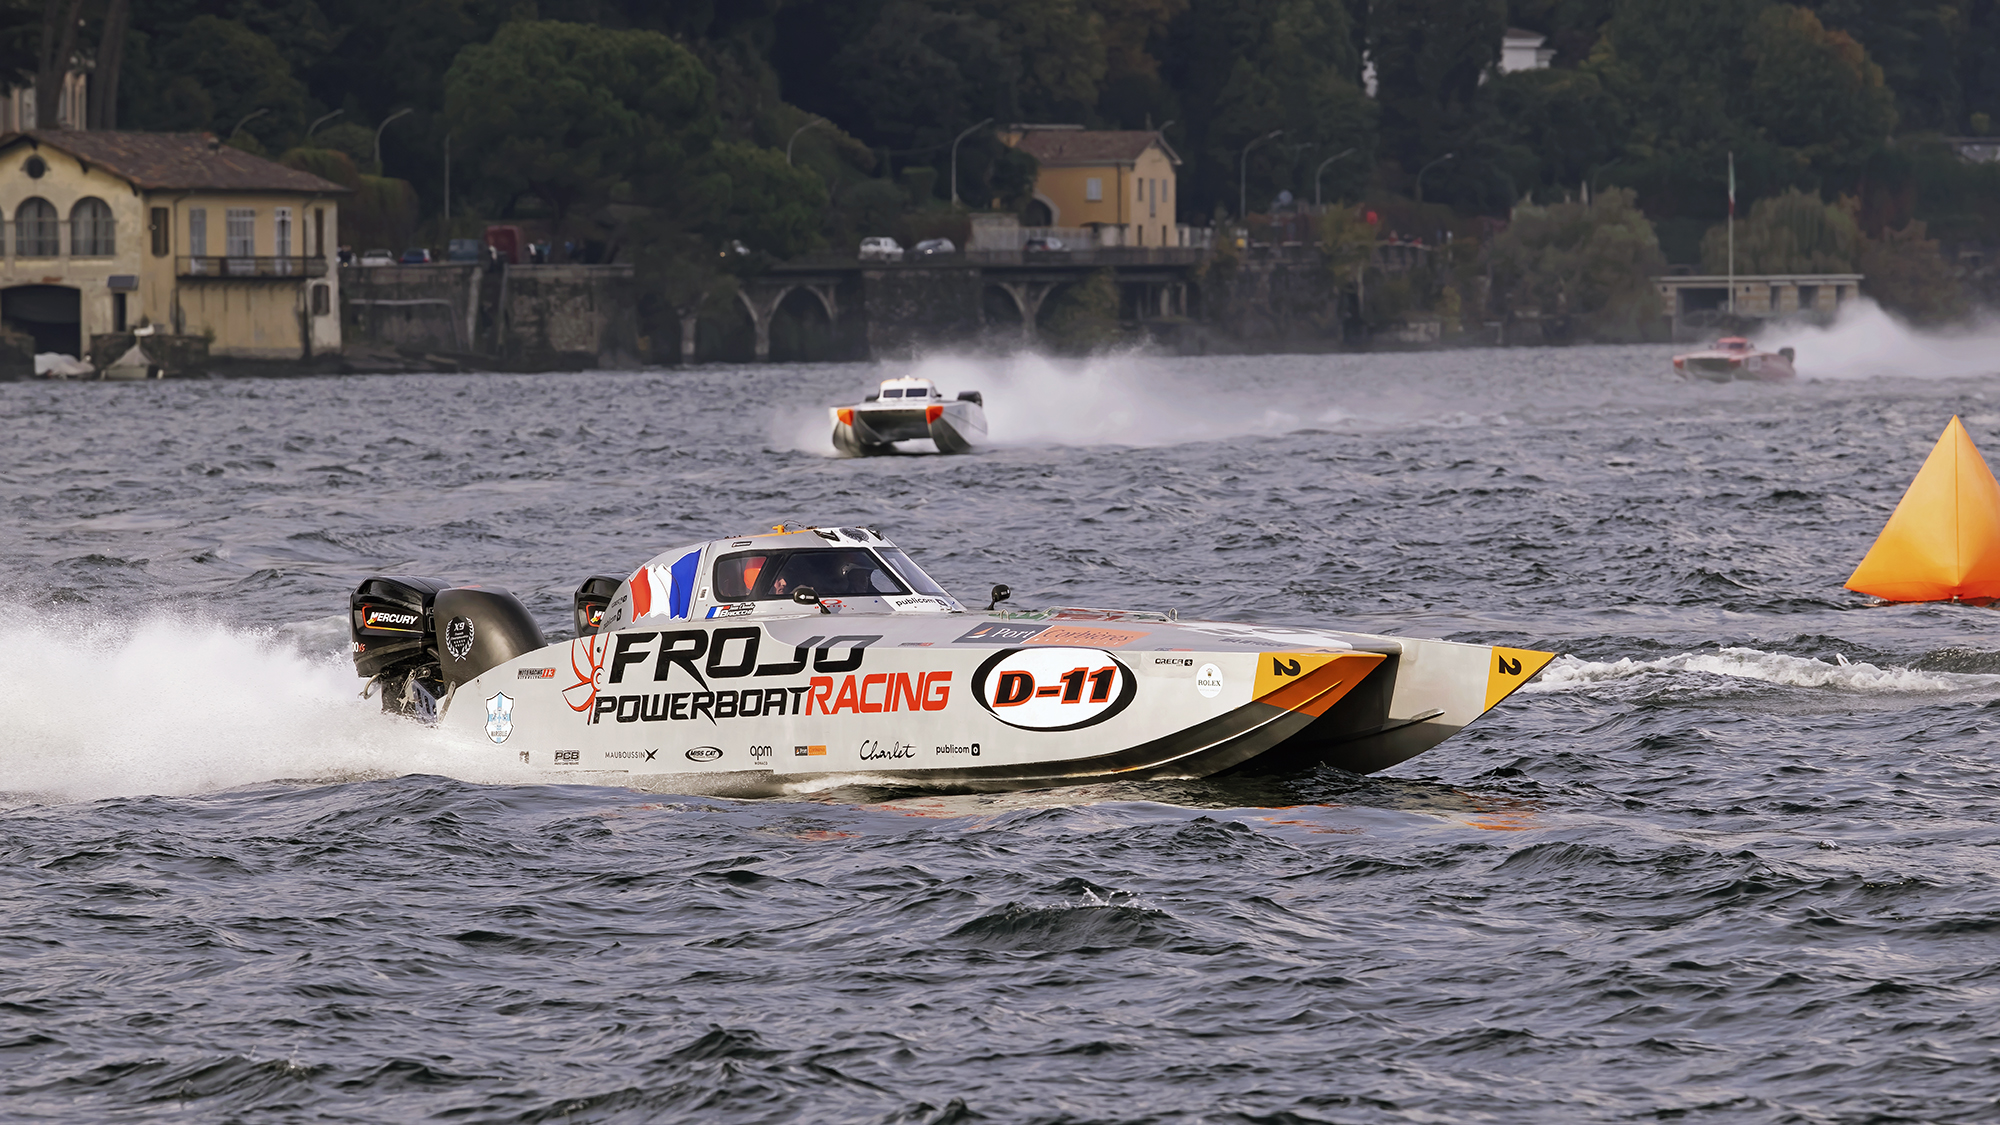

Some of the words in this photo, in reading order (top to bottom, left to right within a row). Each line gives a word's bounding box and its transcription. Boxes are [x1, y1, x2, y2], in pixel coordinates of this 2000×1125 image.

[896, 598, 936, 606] publicom
[367, 611, 418, 625] MERCURY
[453, 622, 465, 631] X9
[991, 627, 1036, 639] Port
[608, 626, 884, 690] FROJO
[1498, 654, 1523, 676] 2
[1273, 656, 1301, 677] 2
[992, 666, 1117, 708] D-11
[1197, 679, 1222, 688] ROLEX
[592, 685, 812, 727] POWERBOAT
[804, 671, 953, 716] RACING
[554, 751, 580, 760] PCB
[604, 751, 645, 759] MAUBOUSSIN
[750, 745, 773, 760] apm
[860, 739, 917, 761] Charlet
[935, 744, 970, 755] publicom
